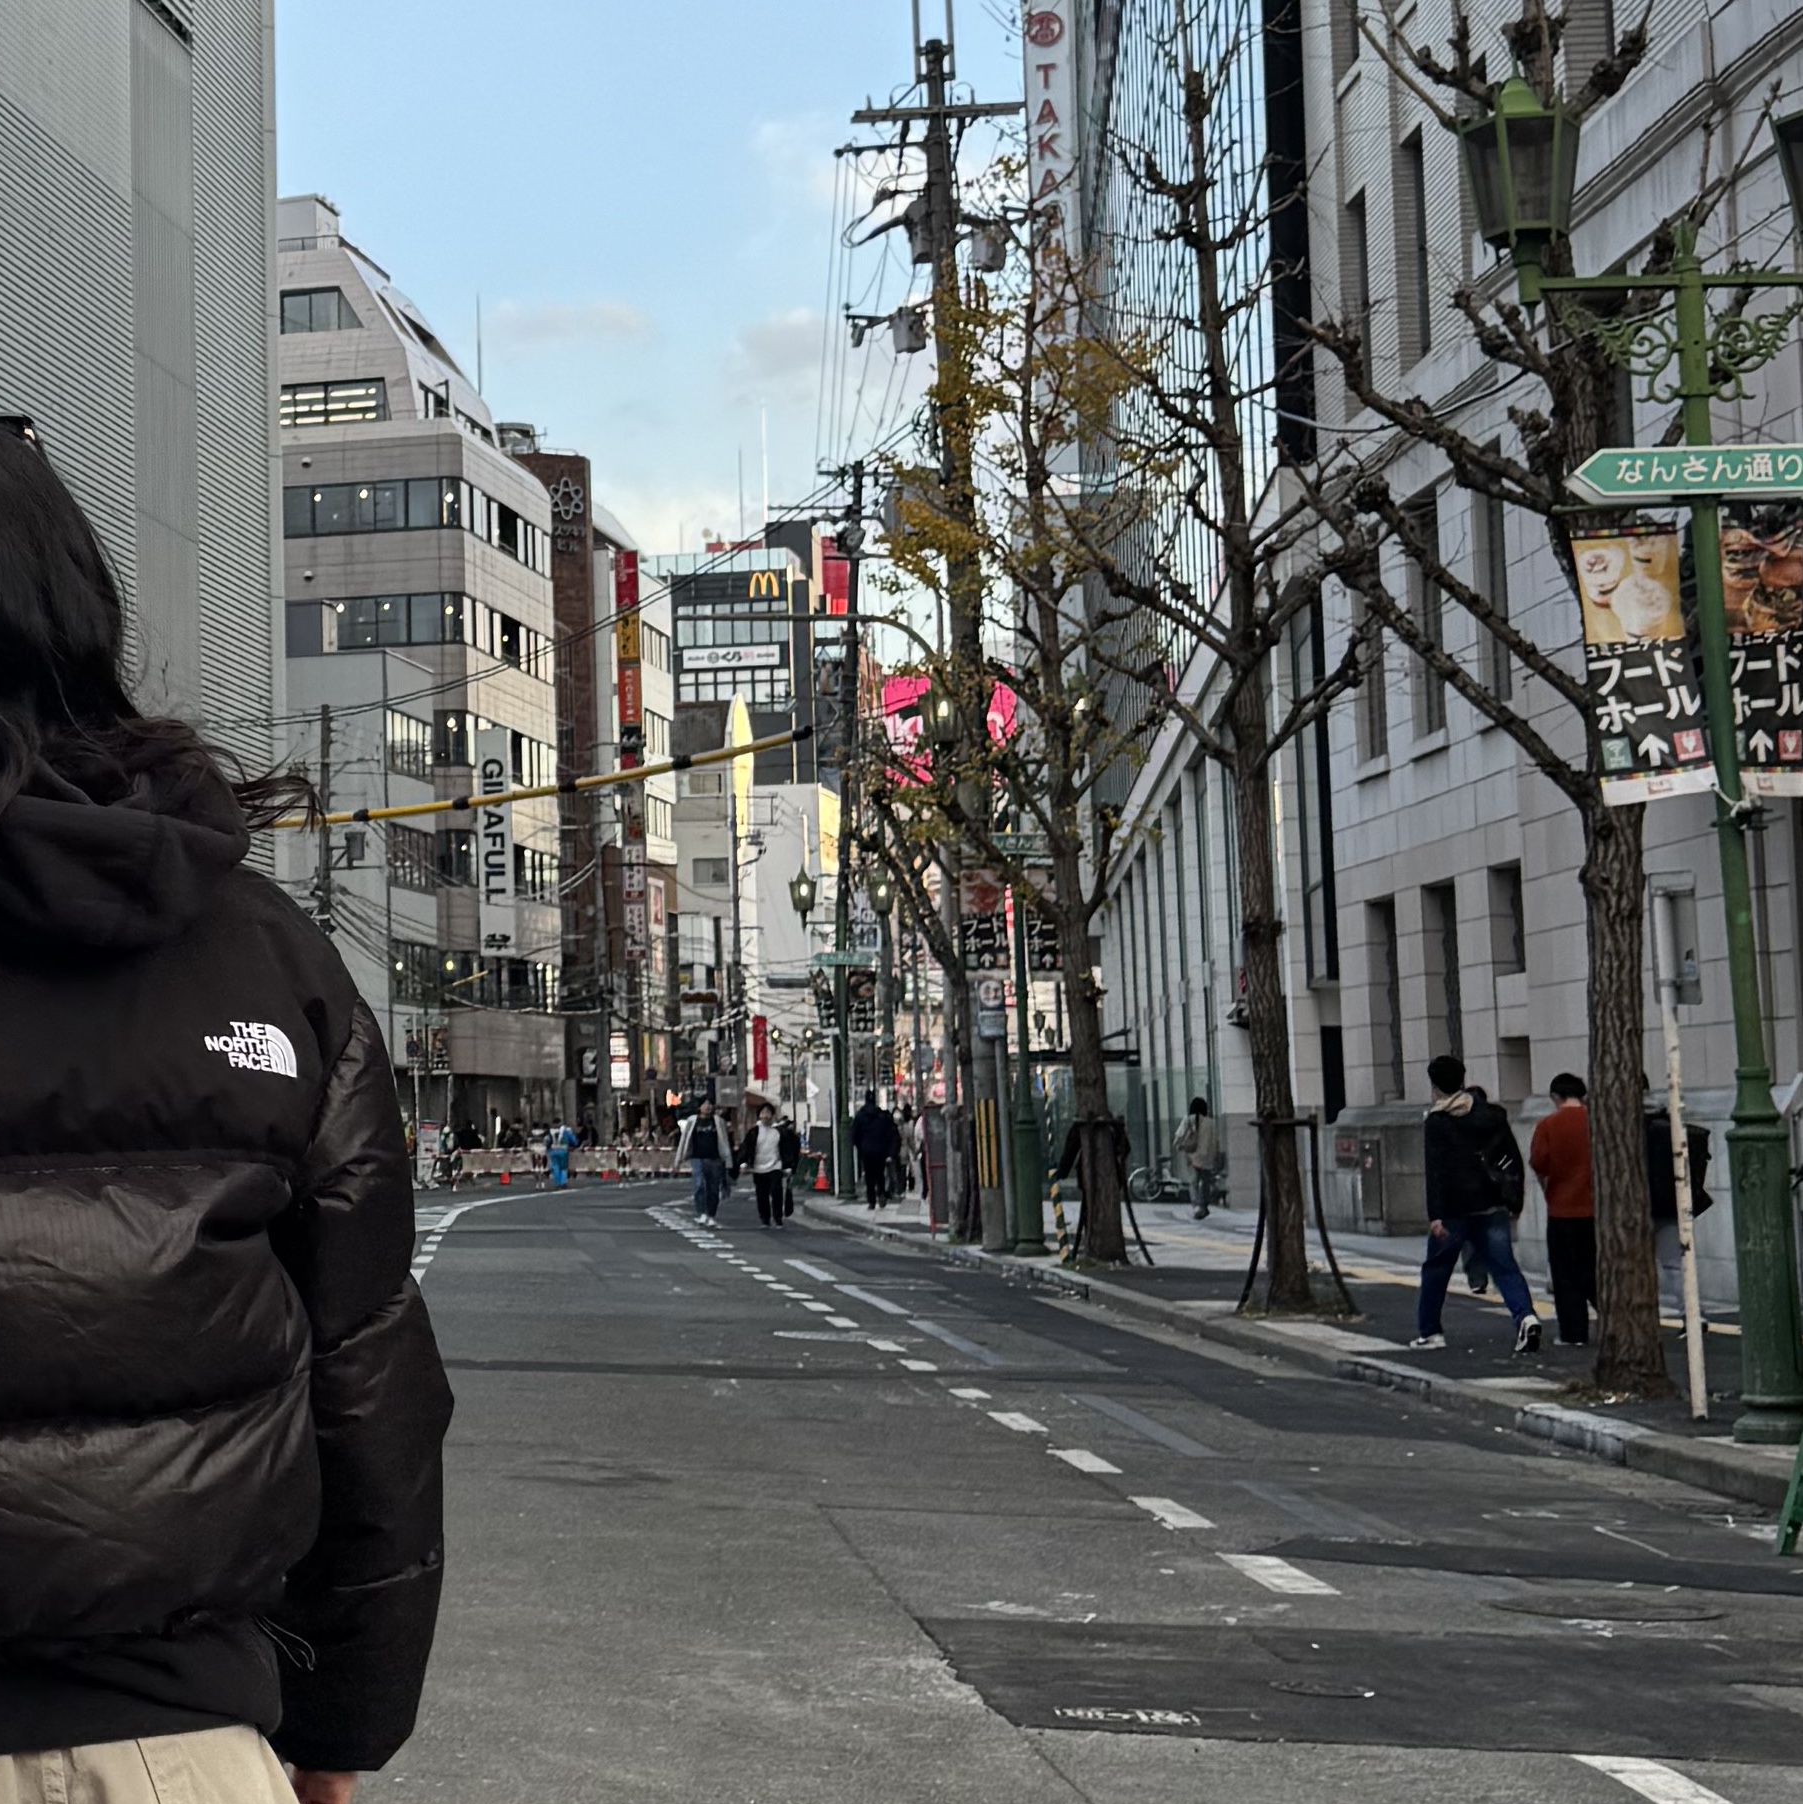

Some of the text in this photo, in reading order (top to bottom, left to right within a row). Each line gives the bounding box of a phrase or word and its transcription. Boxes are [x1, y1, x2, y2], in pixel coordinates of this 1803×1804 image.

[1616, 453, 1803, 483] なんさん通り
[1589, 647, 1684, 696] フード
[1729, 643, 1802, 685] フード
[1595, 685, 1701, 733] ホール
[962, 917, 1005, 936] フード
[1028, 919, 1056, 936] フー
[965, 934, 1009, 951] ホール
[1029, 937, 1060, 951] ホー
[229, 1021, 267, 1040] THE
[204, 1035, 268, 1055] NORTH
[227, 1052, 273, 1072] FACE
